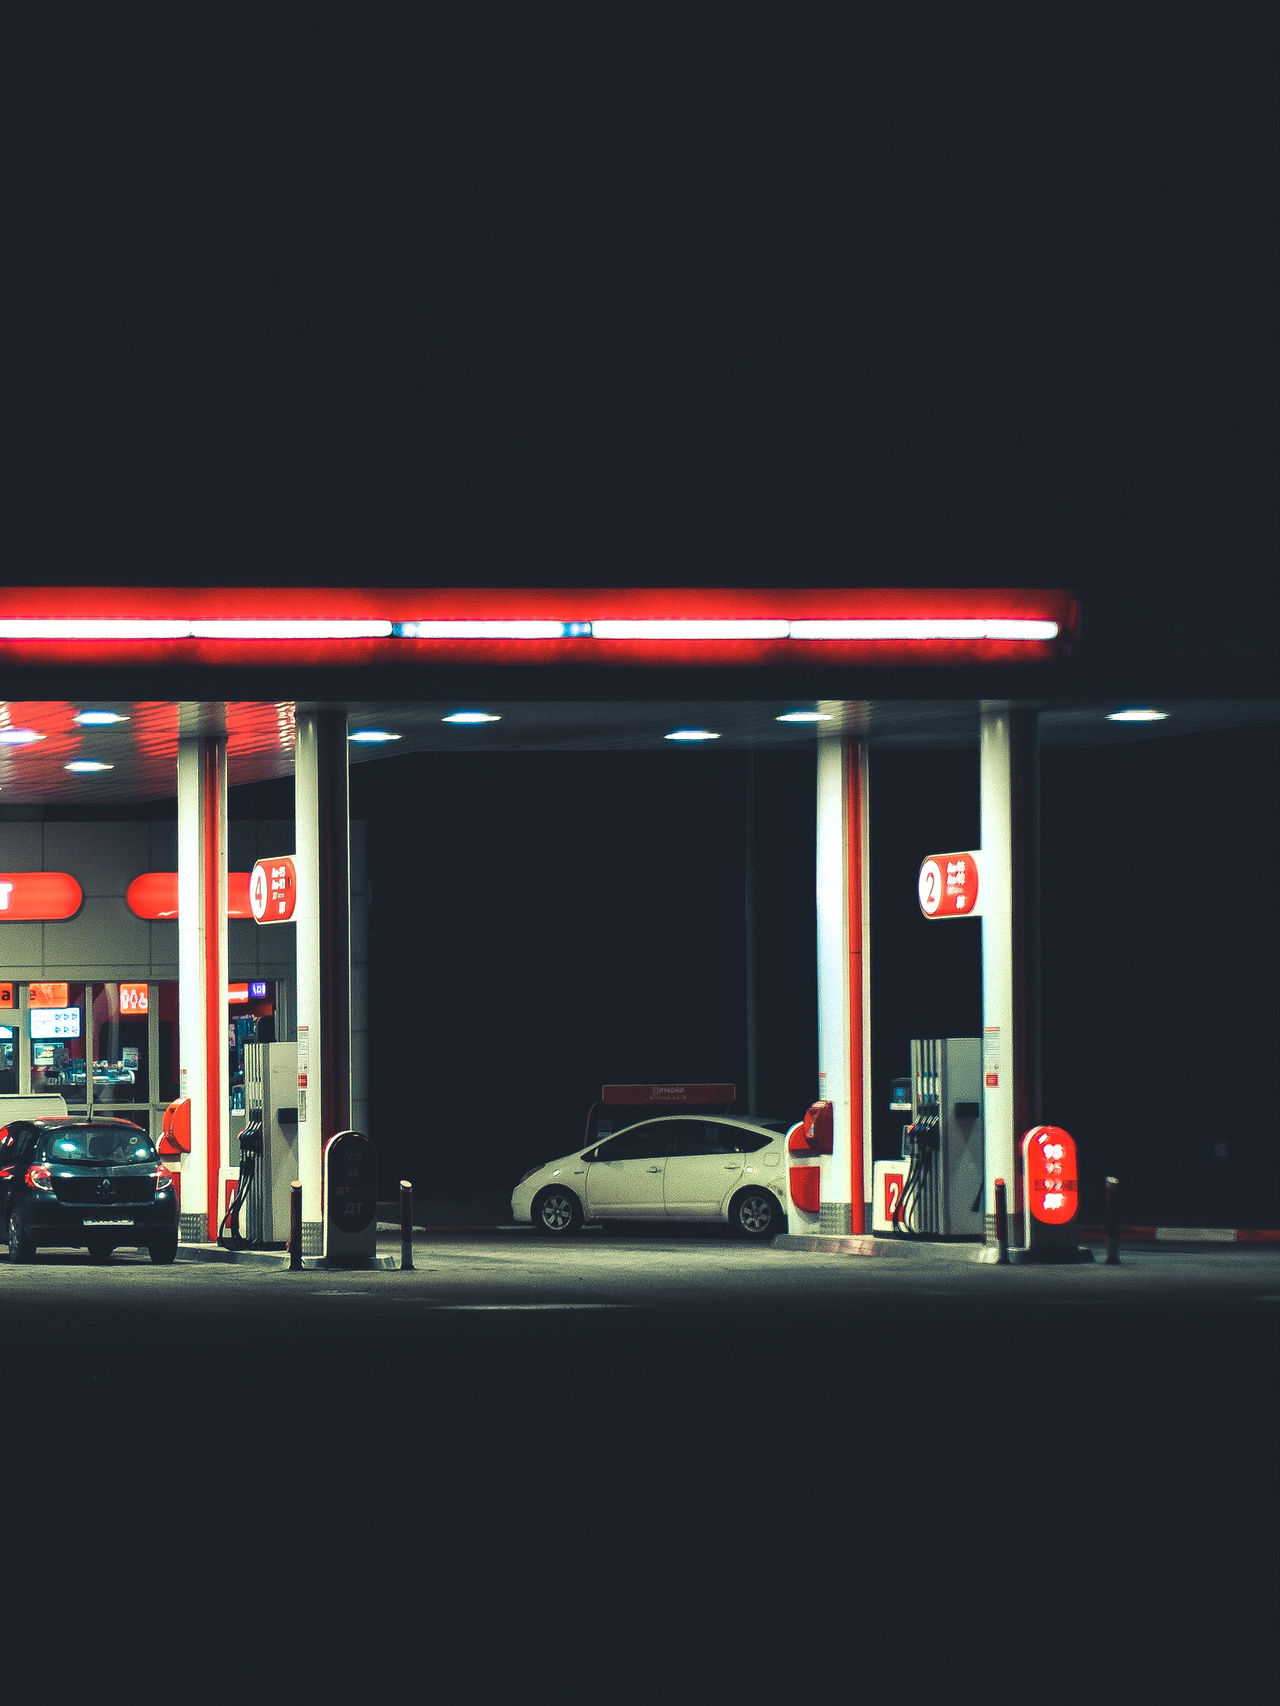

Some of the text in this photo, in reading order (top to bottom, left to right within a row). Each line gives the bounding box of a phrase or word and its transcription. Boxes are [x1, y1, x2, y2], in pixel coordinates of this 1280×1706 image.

[255, 875, 262, 908] 4
[925, 872, 935, 903] 2
[889, 1182, 899, 1213] 2
